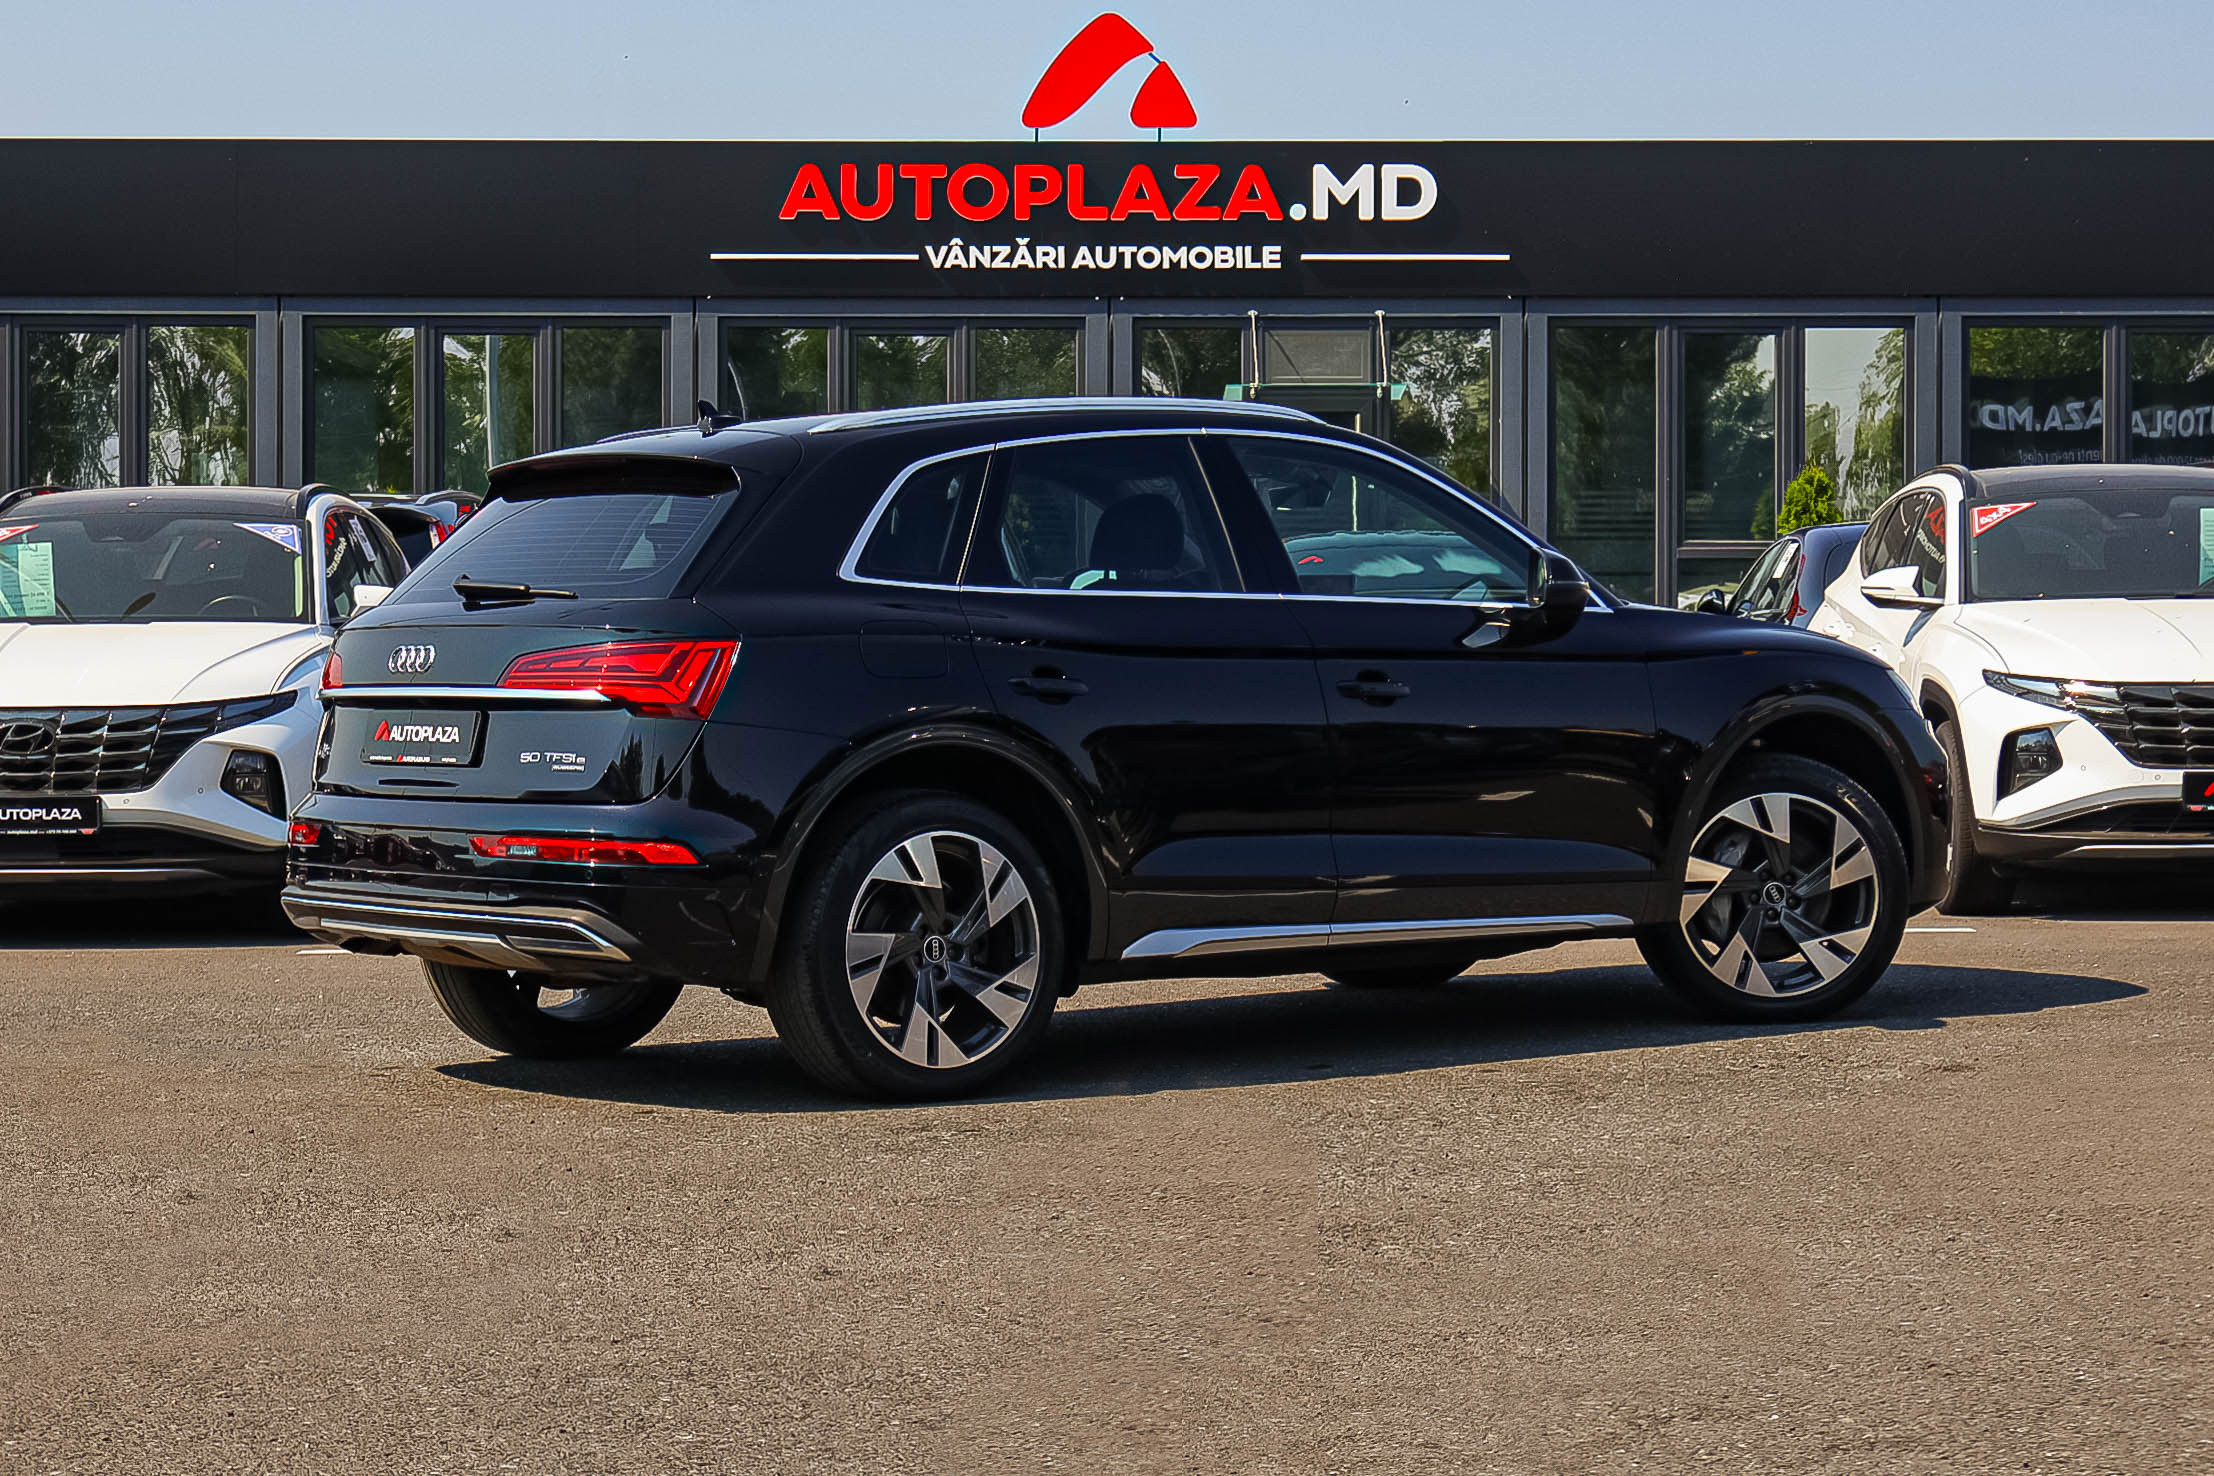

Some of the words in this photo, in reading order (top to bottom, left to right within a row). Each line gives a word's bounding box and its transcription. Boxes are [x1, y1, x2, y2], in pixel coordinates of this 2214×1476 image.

[778, 163, 1438, 222] AUTOPLAZA.MD
[925, 237, 1066, 270] VÂNZĂRI
[1071, 245, 1282, 270] AUTOMOBILE
[389, 725, 460, 743] AUTOPLAZA
[520, 752, 541, 763] 50
